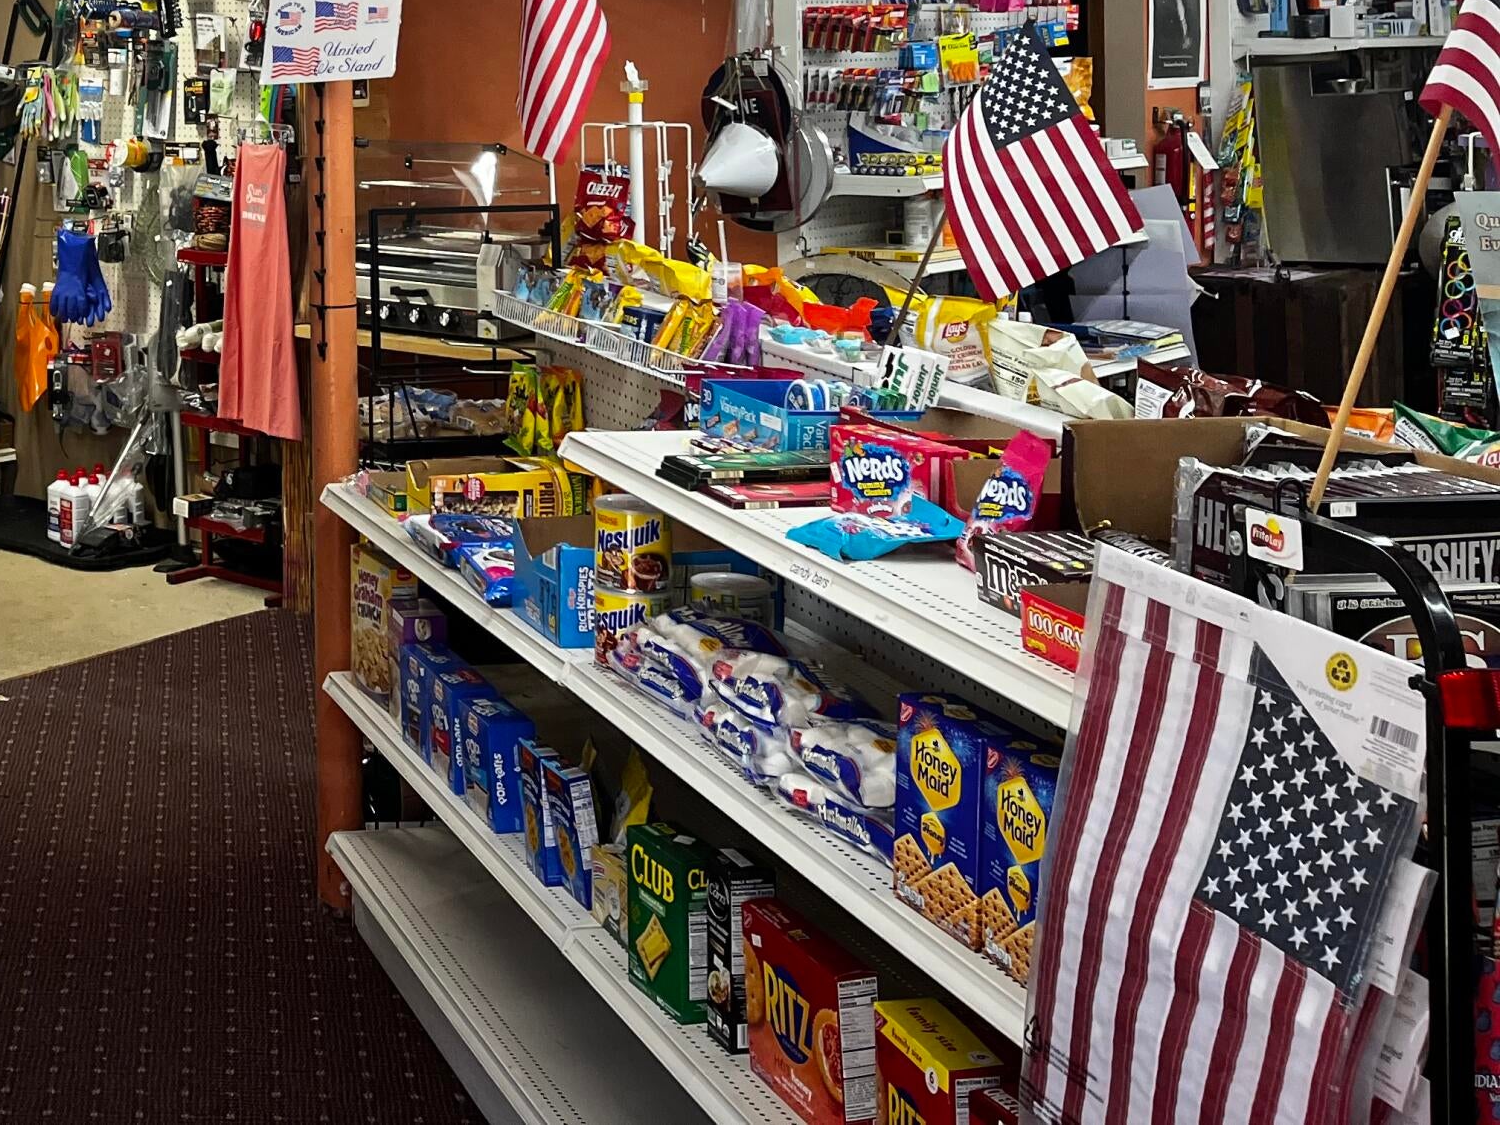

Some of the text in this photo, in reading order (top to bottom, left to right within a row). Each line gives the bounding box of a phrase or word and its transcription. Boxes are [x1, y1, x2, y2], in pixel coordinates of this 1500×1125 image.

[323, 38, 377, 57] United
[314, 56, 386, 75] We Stand
[789, 563, 830, 589] candy bars
[577, 566, 589, 632] RICE KRISPIES
[597, 602, 646, 636] squik
[1028, 609, 1053, 635] 100
[915, 740, 957, 785] Honey
[918, 765, 949, 798] Maid
[1001, 788, 1041, 836] Honey
[1003, 814, 1034, 851] Maid
[631, 843, 674, 903] CLUB
[687, 868, 708, 890] CL
[762, 960, 813, 1057] RITZ
[906, 1006, 957, 1052] family size
